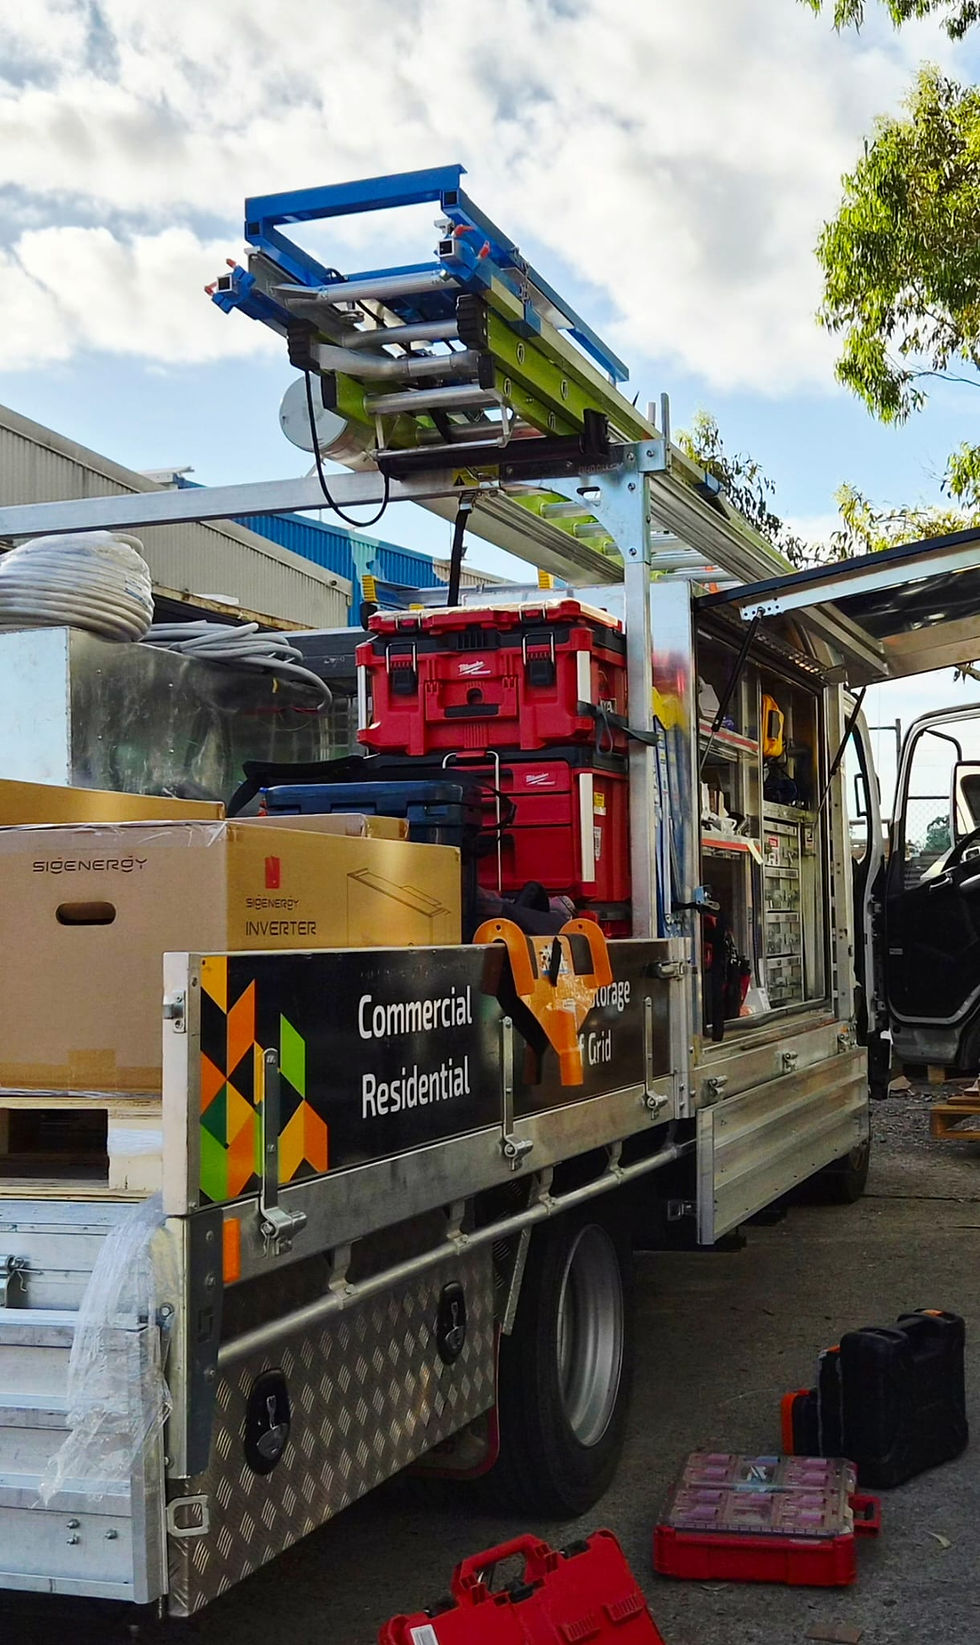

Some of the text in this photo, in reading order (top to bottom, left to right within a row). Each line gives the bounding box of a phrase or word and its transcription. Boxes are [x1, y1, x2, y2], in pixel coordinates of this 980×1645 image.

[32, 856, 148, 874] SIGENERGY
[245, 921, 317, 936] INVERTER
[359, 985, 472, 1039] Commercial
[592, 980, 631, 1012] torage
[588, 1029, 612, 1066] Grid
[362, 1055, 471, 1119] Residential
